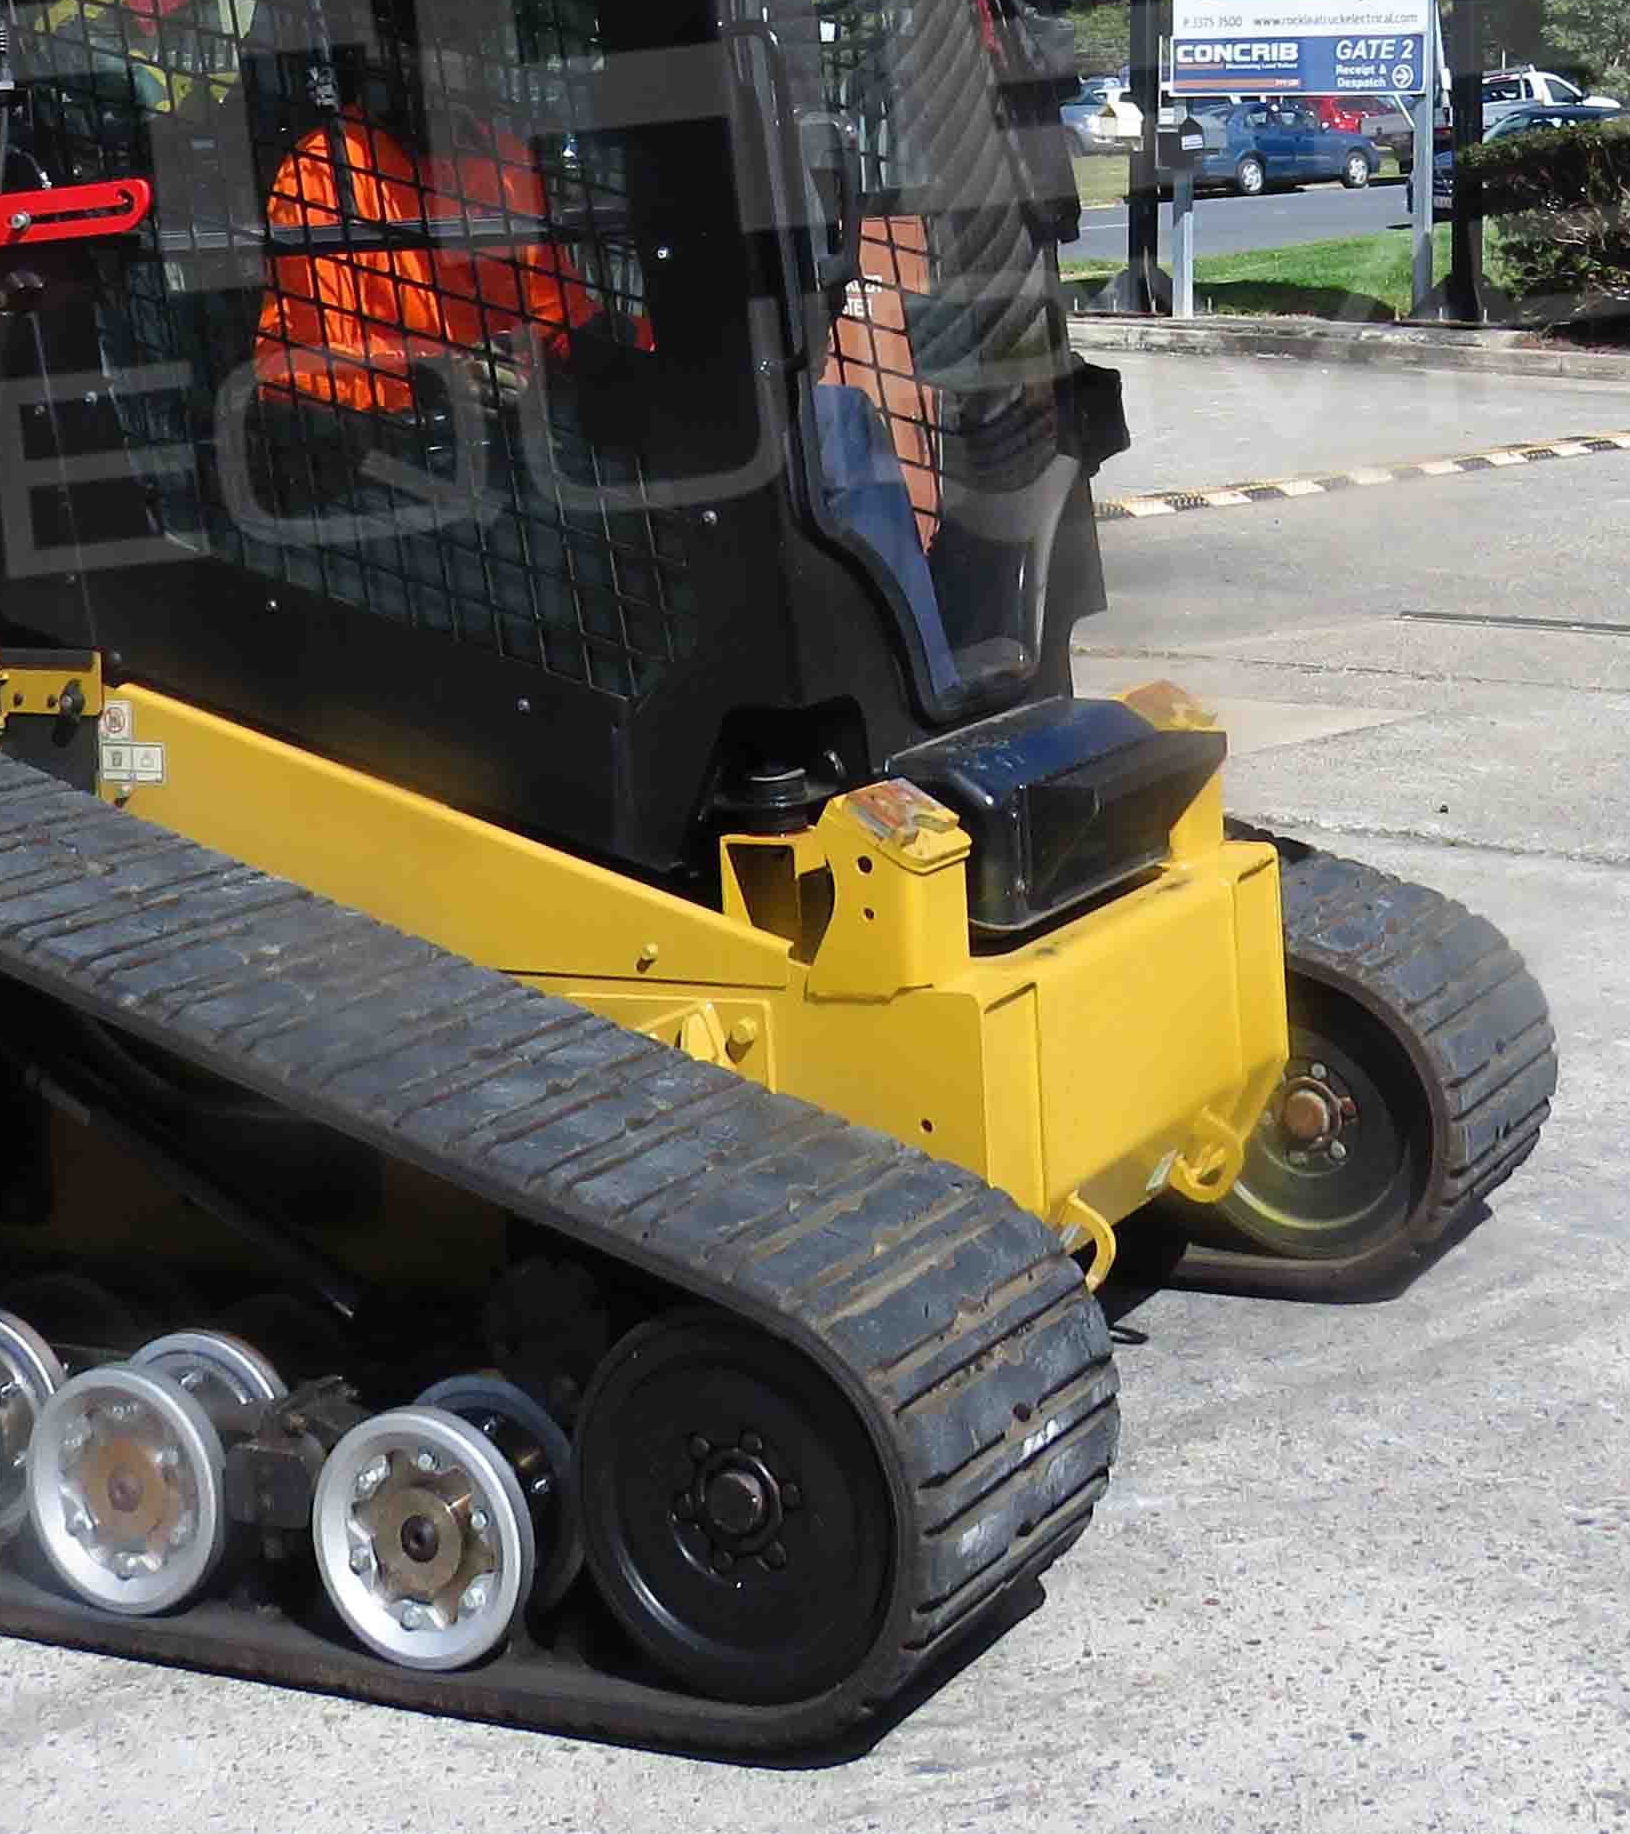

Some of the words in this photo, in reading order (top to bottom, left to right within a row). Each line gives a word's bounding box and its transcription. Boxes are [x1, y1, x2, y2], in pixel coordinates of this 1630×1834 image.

[1176, 42, 1299, 63] CONCRIB
[1335, 39, 1396, 61] GATE
[1401, 38, 1415, 59] 2
[1335, 64, 1376, 78] Receipt
[1336, 76, 1387, 90] Despatch
